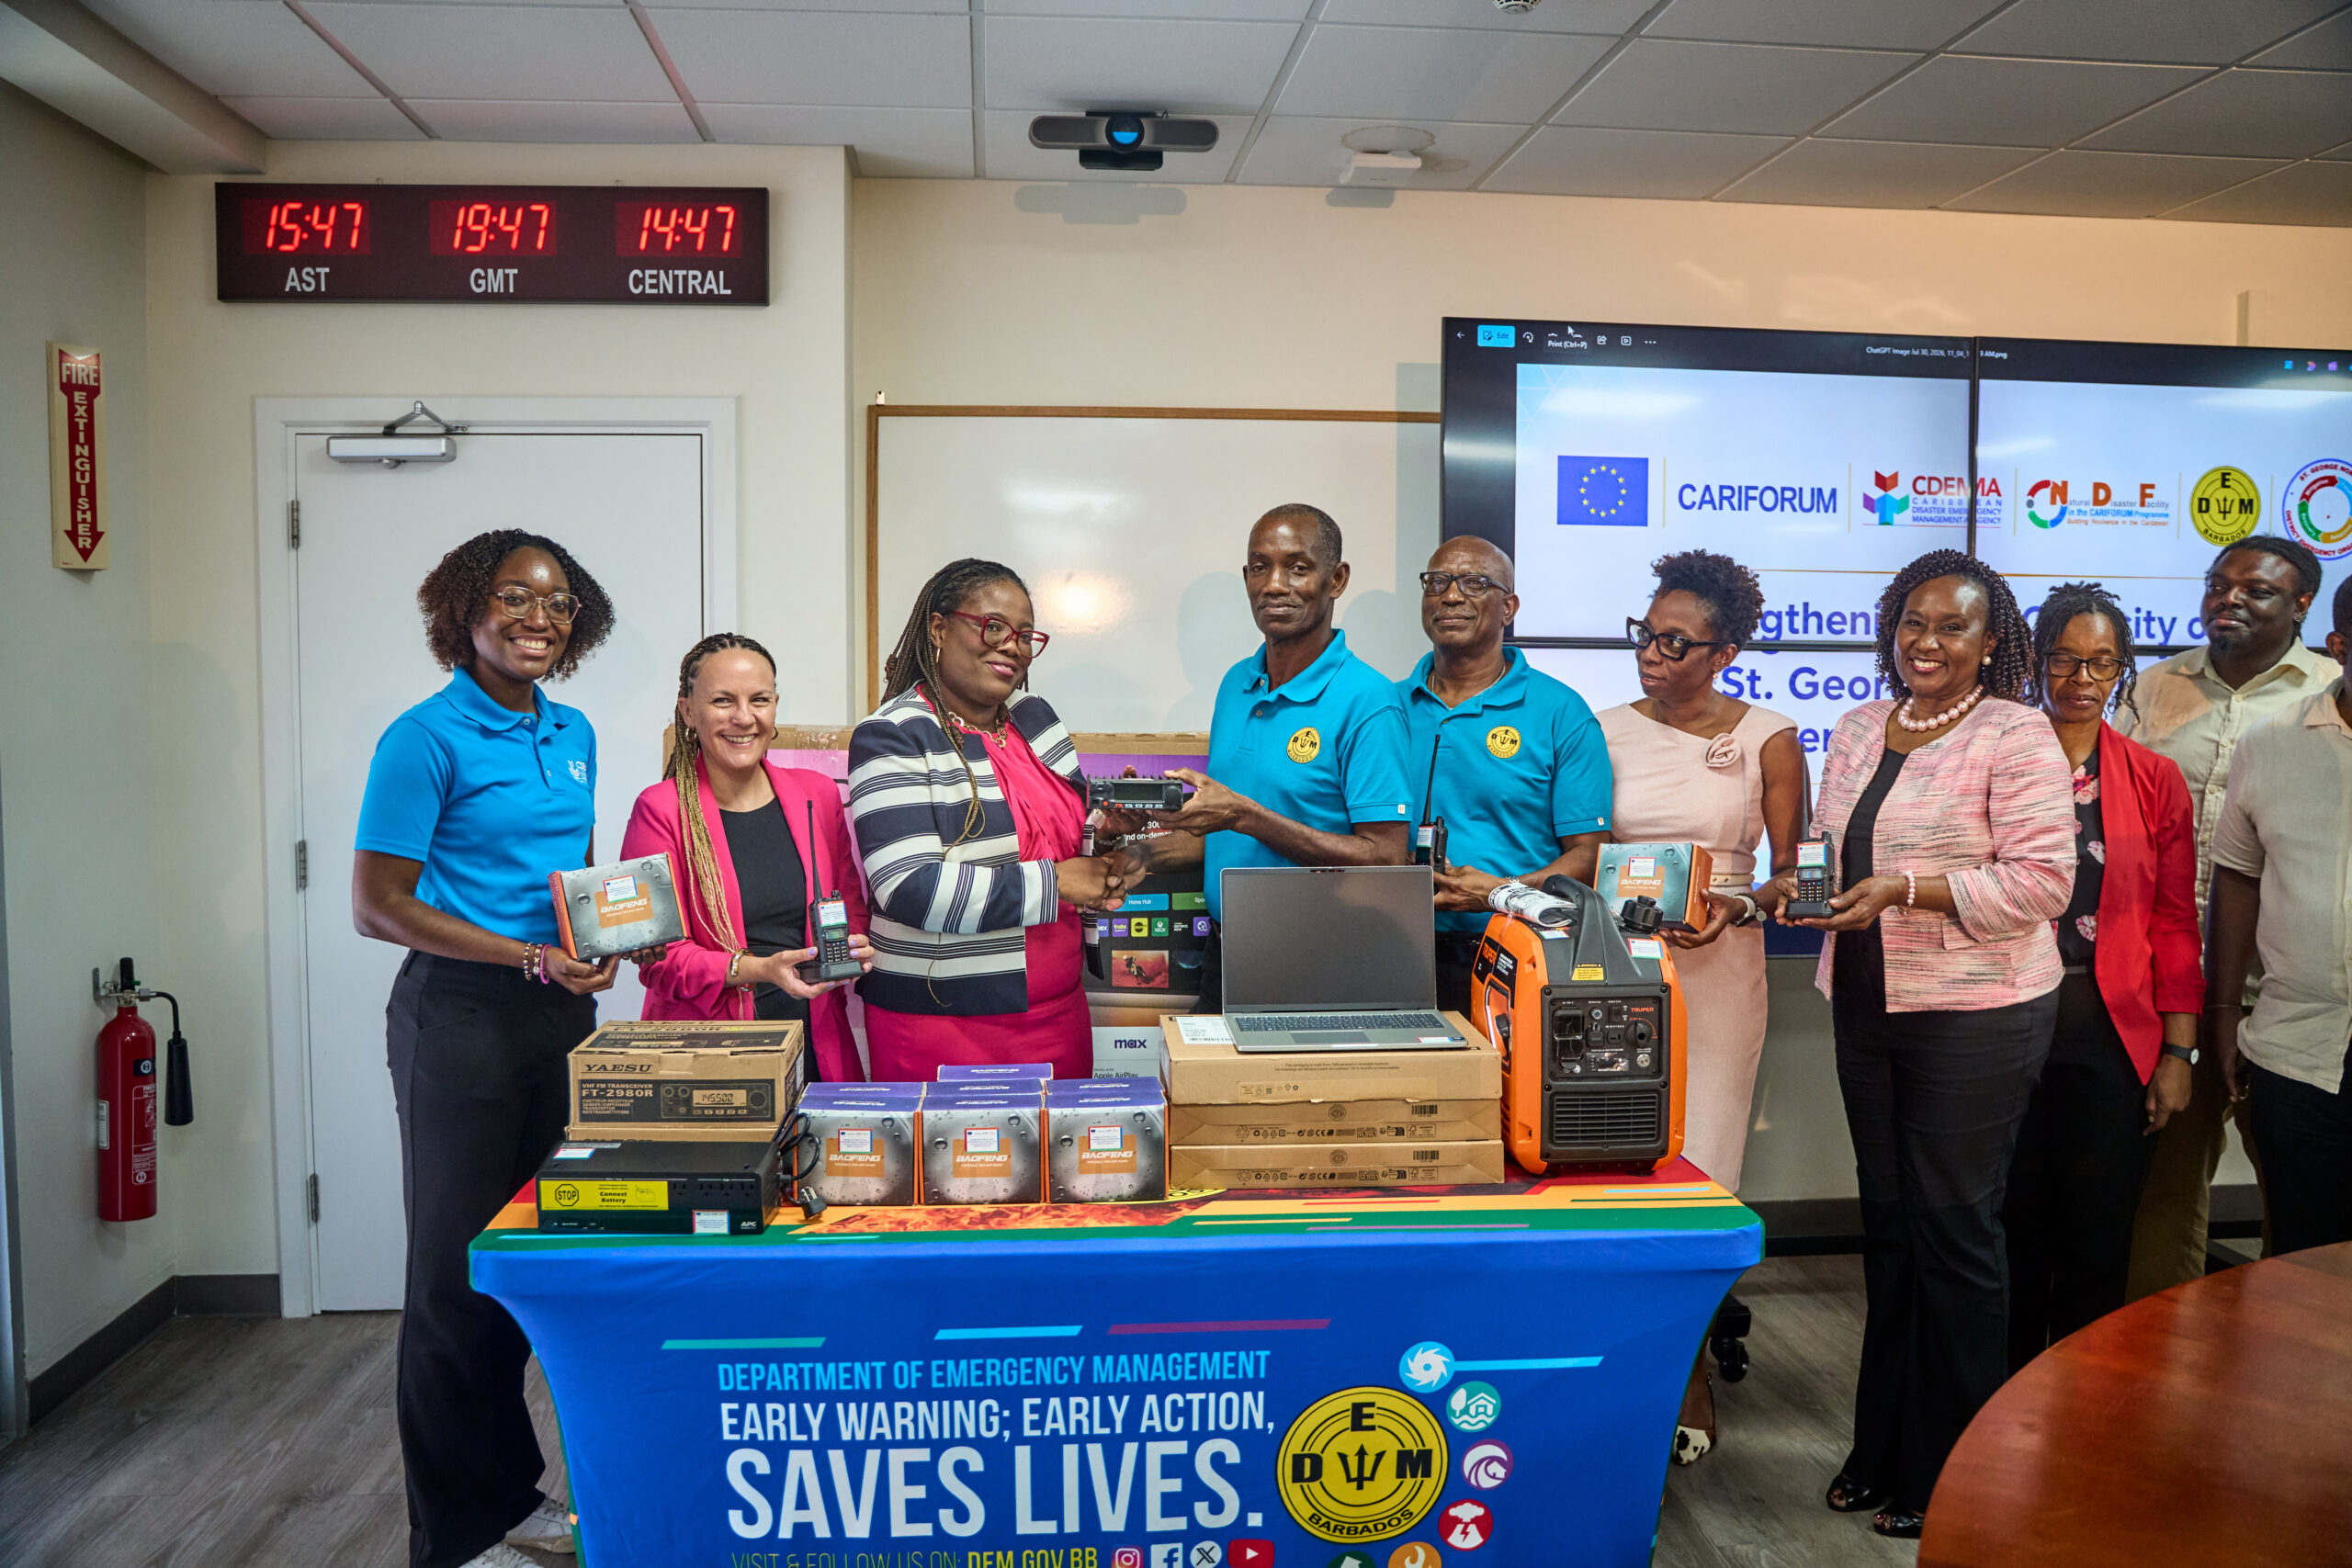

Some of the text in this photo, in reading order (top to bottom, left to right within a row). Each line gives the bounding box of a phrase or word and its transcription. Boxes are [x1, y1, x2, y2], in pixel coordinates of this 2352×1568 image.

[265, 201, 364, 253] 15:47
[452, 203, 549, 253] 19:47
[638, 205, 736, 253] 14:47
[284, 267, 330, 292] AST
[469, 268, 519, 294] GMT
[628, 269, 732, 295] CENTRAL
[1547, 340, 1563, 348] Print
[1866, 346, 1892, 355] ChatGPT
[1893, 347, 1910, 356] Image
[61, 362, 100, 387] FIRE
[74, 391, 93, 549] EXTINGUISHER
[2310, 464, 2338, 474] GEORGE
[1678, 483, 1838, 513] CARIFORUM
[1912, 506, 1945, 514] DISASTER
[2067, 508, 2169, 519] in the CARIFORUM Programme
[1912, 515, 1962, 524] MANAGEMENT
[2202, 528, 2247, 543] BARBADOS
[1721, 665, 1890, 700] St. Geor
[1621, 878, 1662, 886] BAOFENG
[600, 898, 648, 913] BAOFENG
[1114, 1039, 1148, 1049] max
[584, 1064, 653, 1072] YAESU
[582, 1089, 653, 1097] FT-2980R
[829, 1154, 882, 1162] BAOFENG
[1081, 1150, 1134, 1159] BAOFENG
[557, 1190, 577, 1201] STOP
[718, 1350, 1271, 1391] DEPARTMENT OF EMERGENCY MANAGEMENT
[721, 1391, 1275, 1442] EARLY WARNING; EARLY ACTION,
[726, 1438, 1263, 1539] SAVES LIVES.
[1308, 1509, 1414, 1536] BARBADOS
